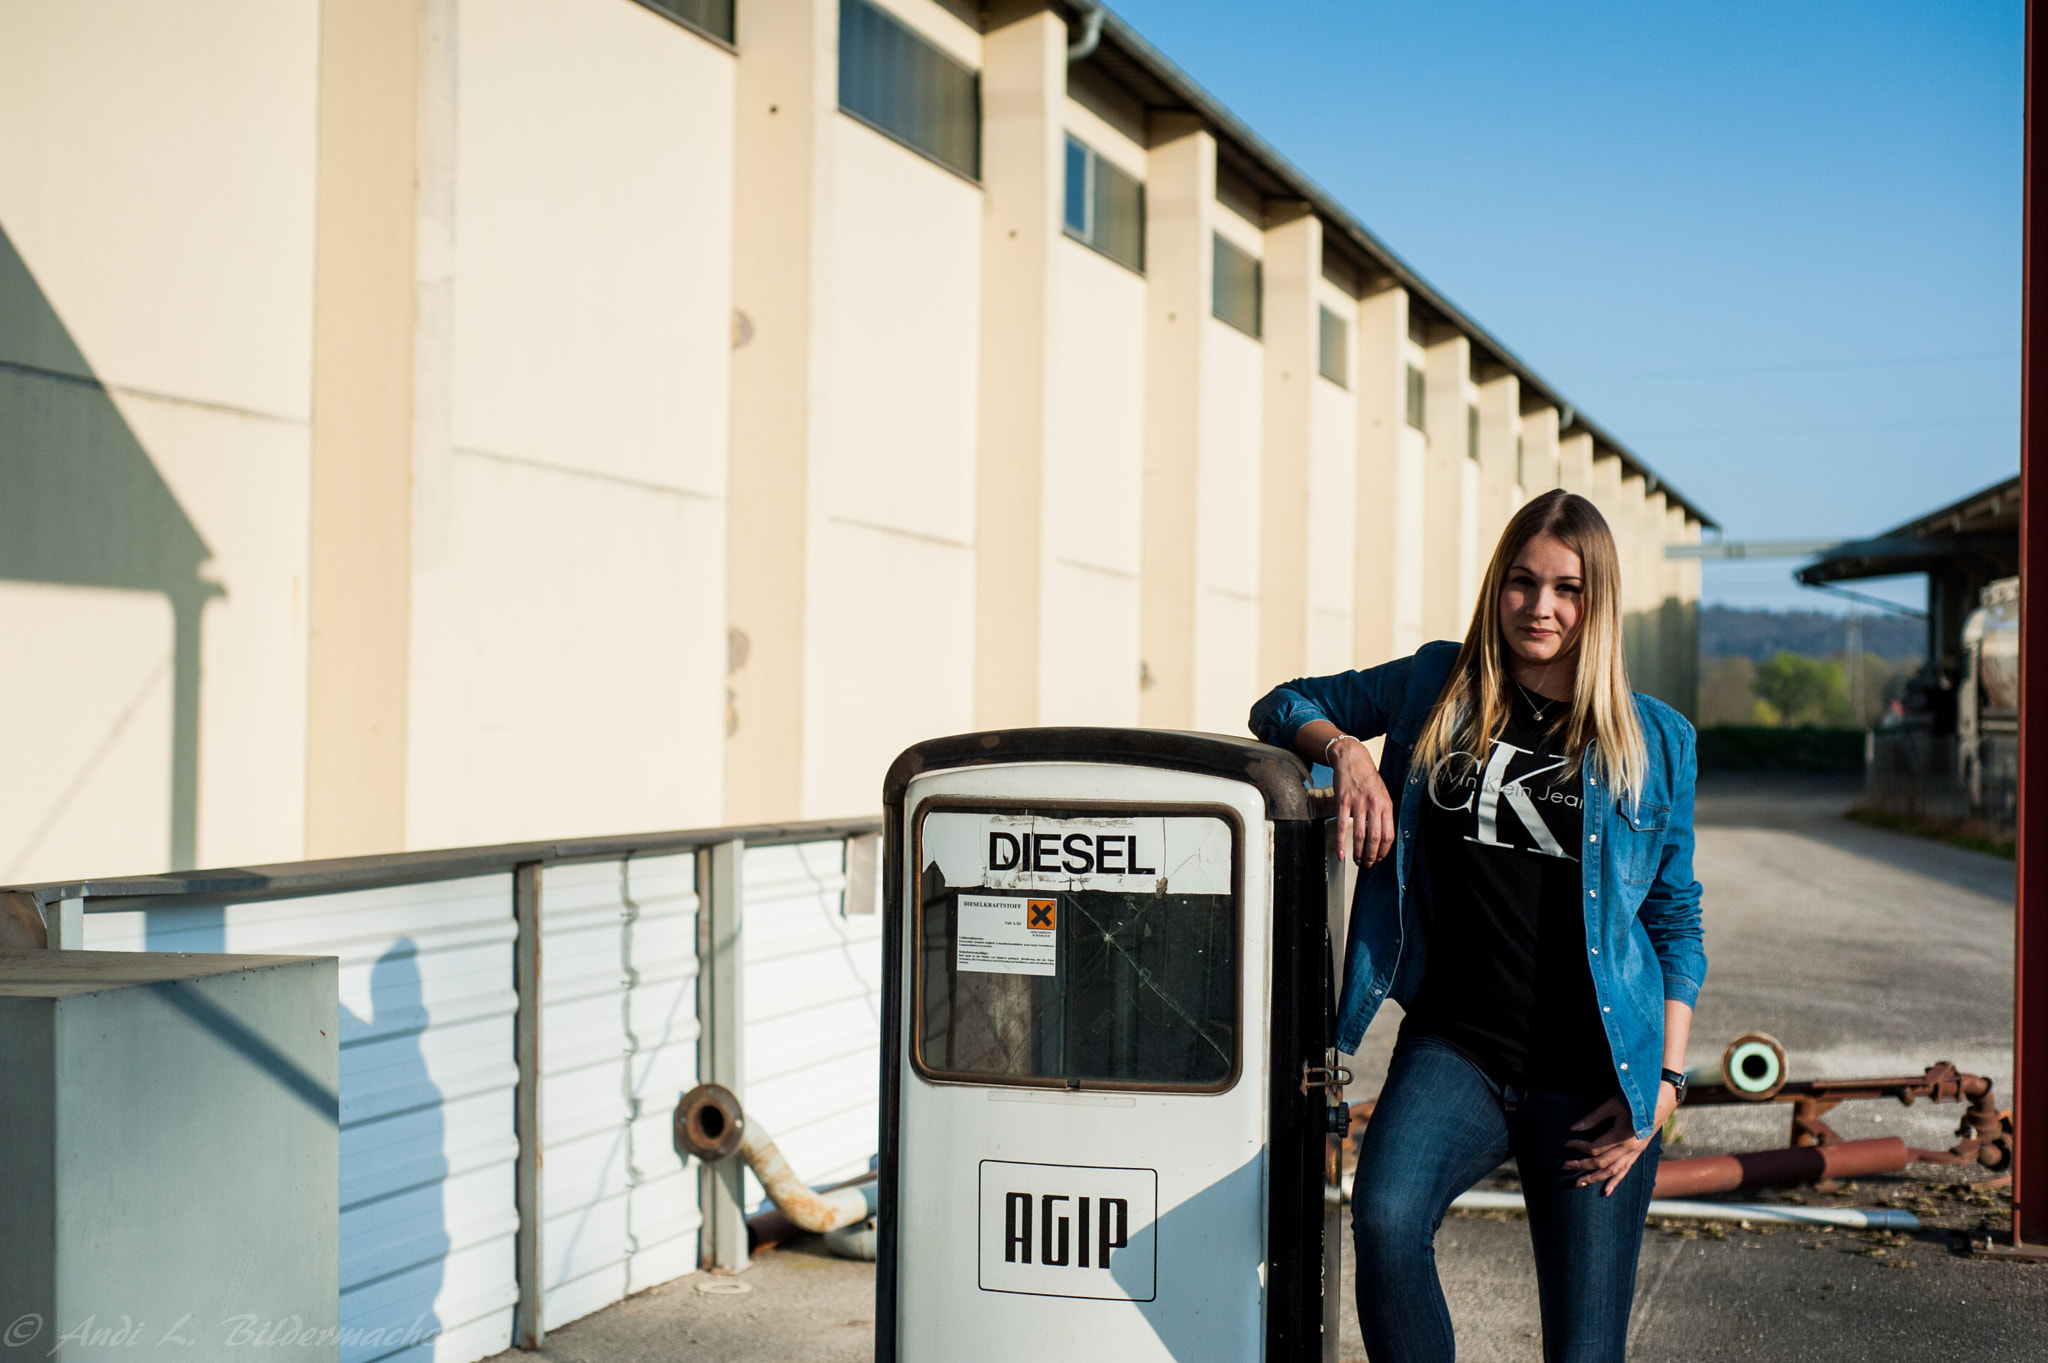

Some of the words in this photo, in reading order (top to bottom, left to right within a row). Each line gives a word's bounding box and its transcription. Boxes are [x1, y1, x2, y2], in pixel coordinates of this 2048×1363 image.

[1485, 776, 1532, 798] Kein
[1538, 785, 1583, 810] Jea
[989, 831, 1156, 875] DIESEL
[964, 901, 1021, 909] DIESELKRAFTSTOFF
[1005, 1192, 1128, 1269] AGIP
